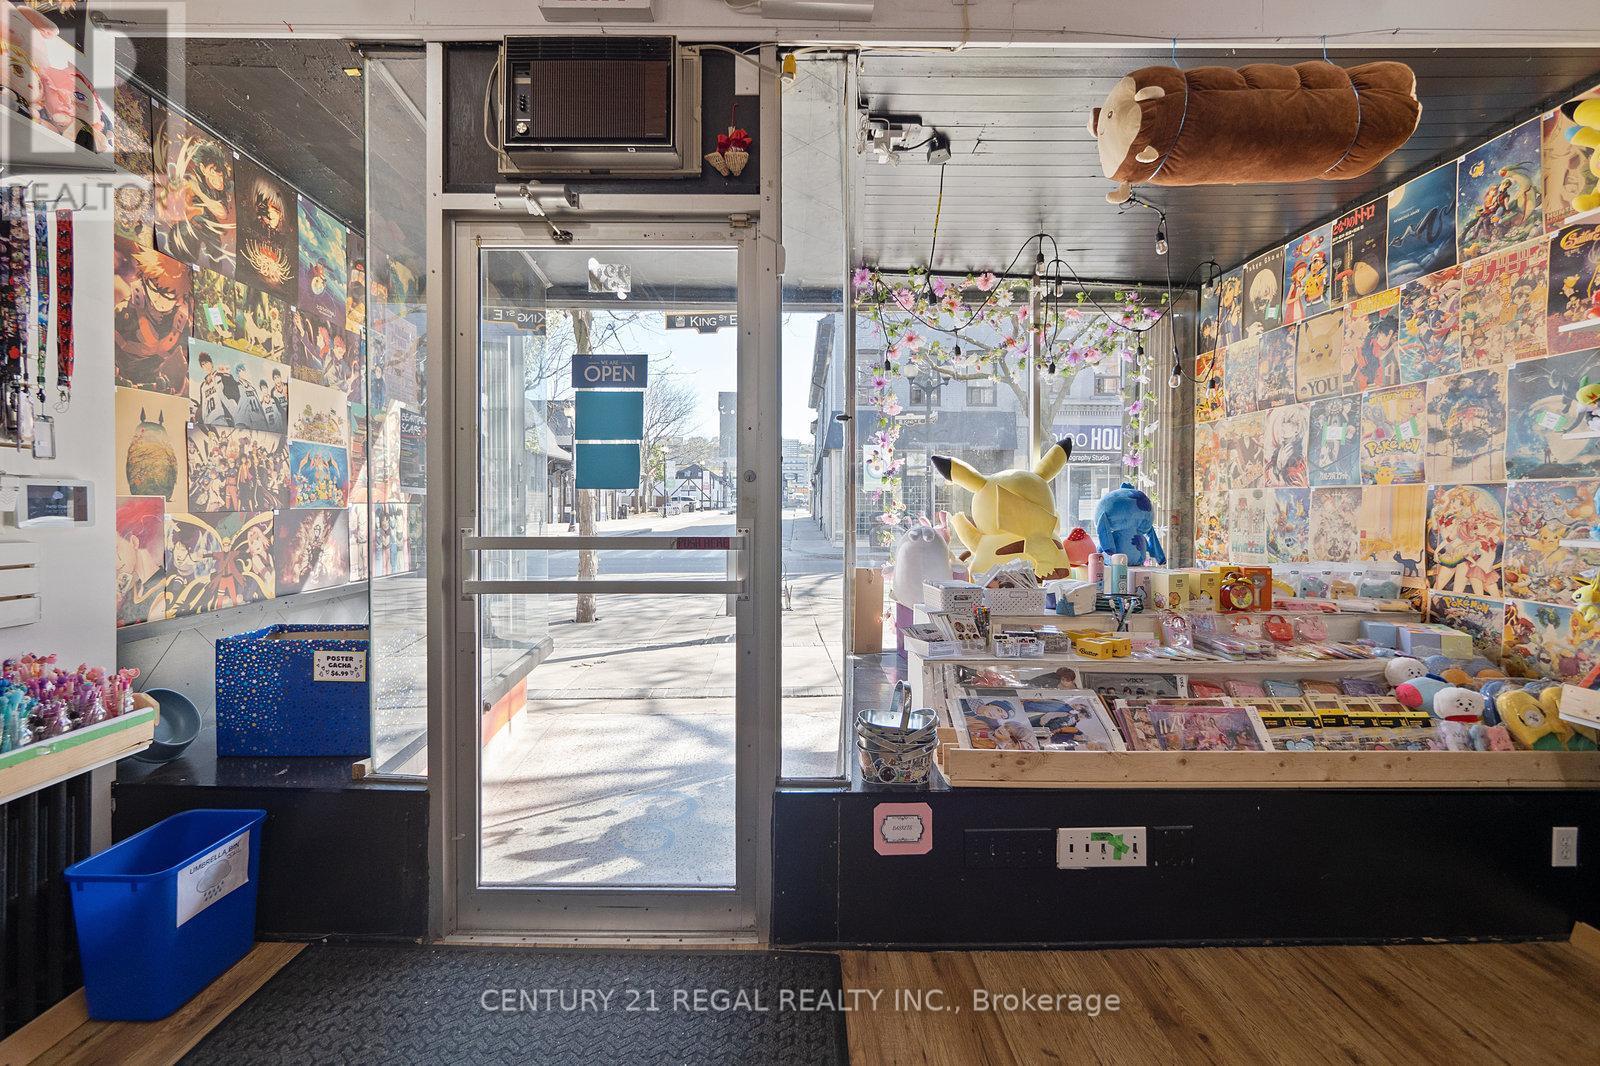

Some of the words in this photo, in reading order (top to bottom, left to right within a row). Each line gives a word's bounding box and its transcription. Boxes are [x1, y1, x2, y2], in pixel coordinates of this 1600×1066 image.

[690, 316, 717, 327] KING
[584, 365, 636, 383] OPEN
[1308, 376, 1340, 396] YOU
[1092, 454, 1110, 462] Studio
[189, 848, 228, 875] UMBRELLA
